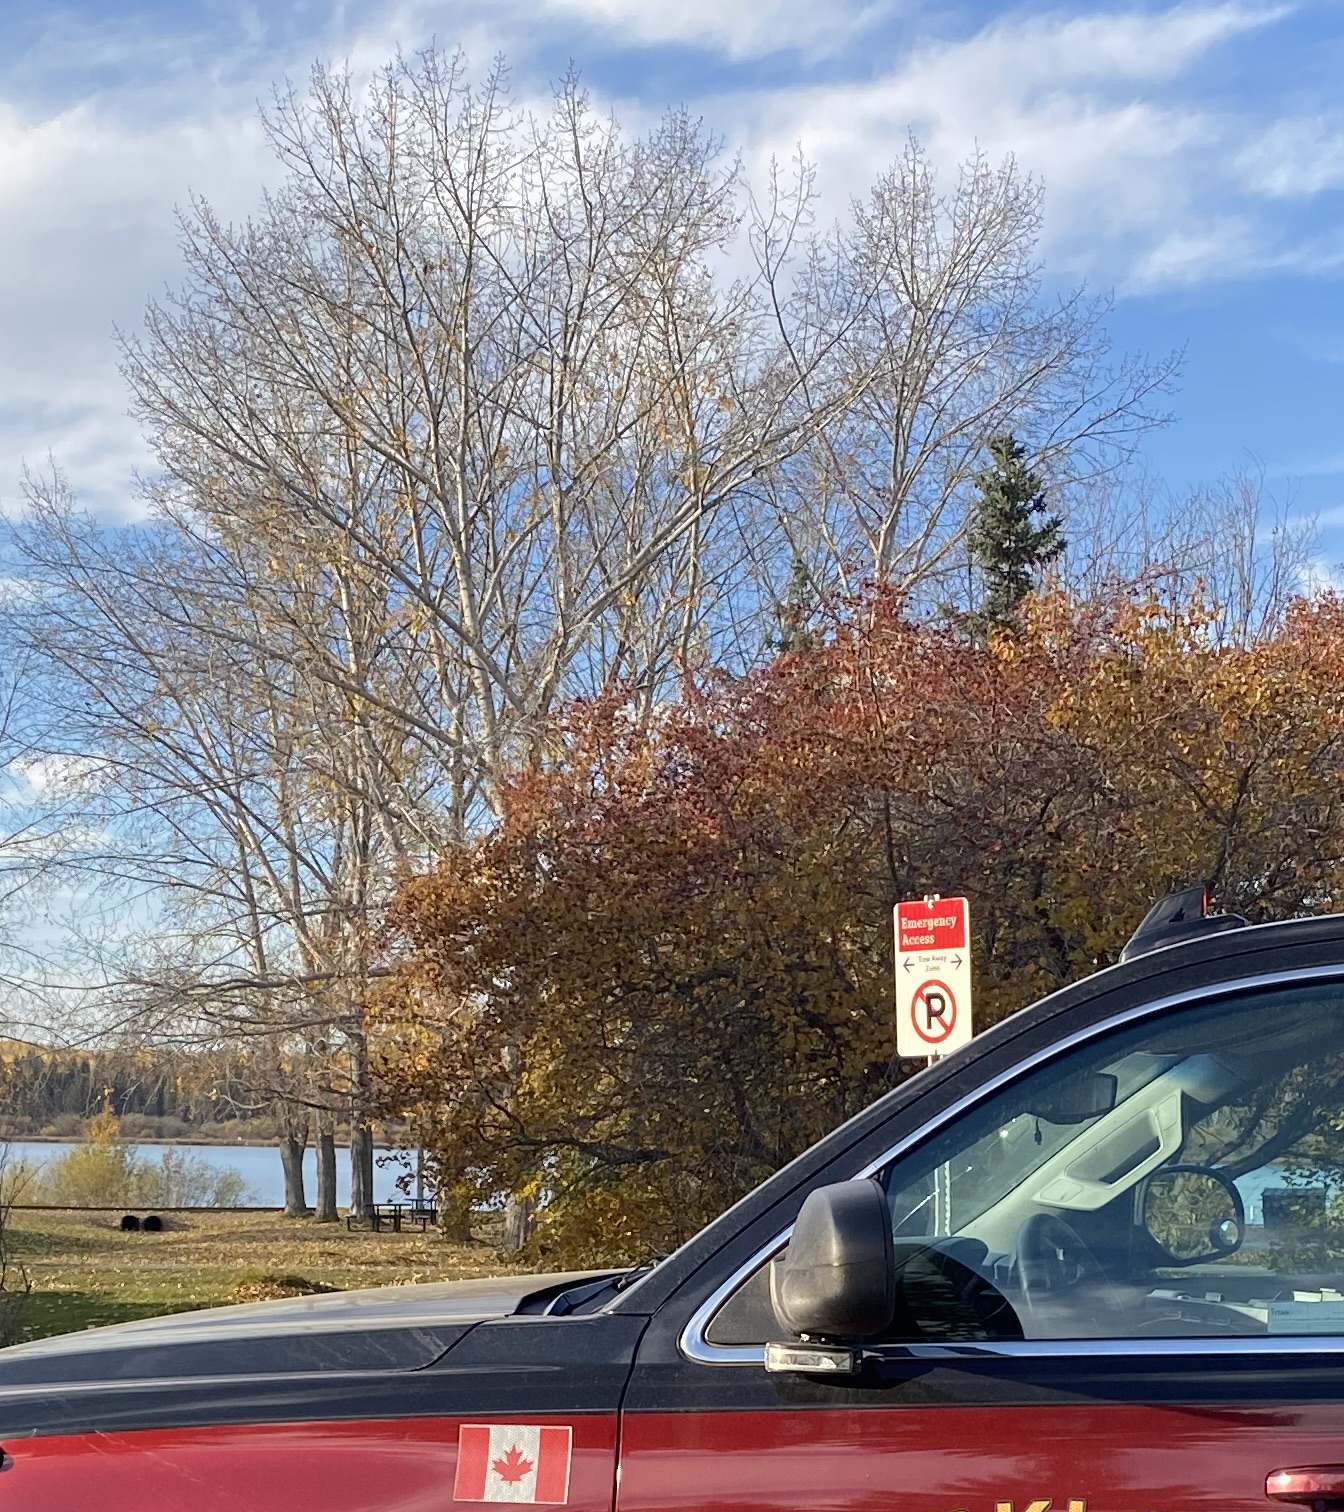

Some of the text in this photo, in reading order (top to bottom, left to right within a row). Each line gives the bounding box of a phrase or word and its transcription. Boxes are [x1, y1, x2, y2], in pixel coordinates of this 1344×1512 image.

[900, 915, 957, 931] Emergency
[901, 933, 935, 946] Access
[931, 955, 947, 963] Away
